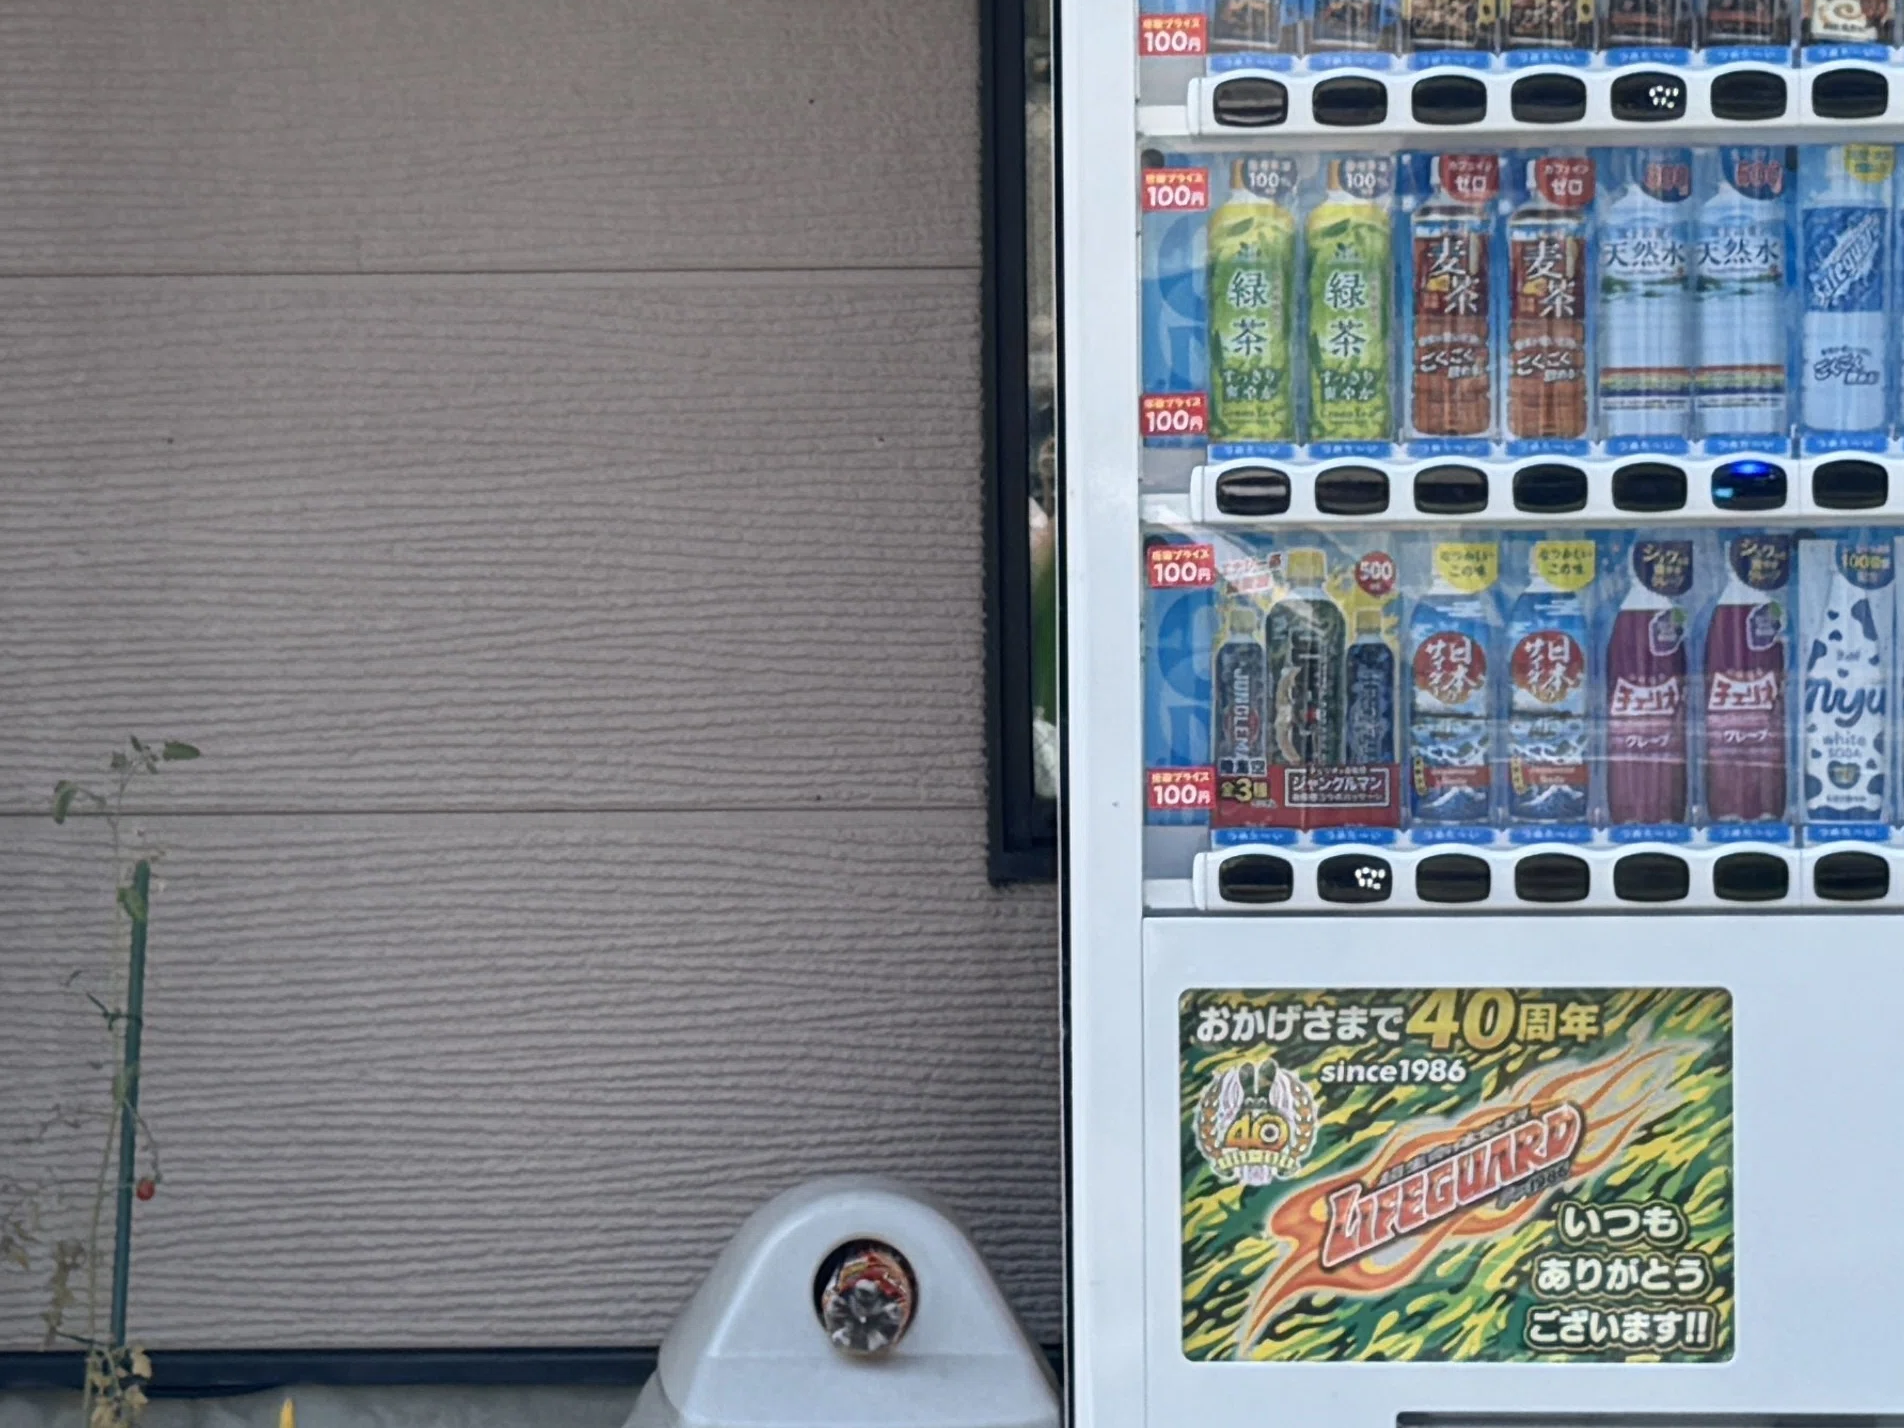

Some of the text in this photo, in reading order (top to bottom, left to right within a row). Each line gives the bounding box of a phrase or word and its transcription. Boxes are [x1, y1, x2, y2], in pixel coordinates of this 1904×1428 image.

[1143, 31, 1201, 52] 100円
[1146, 185, 1204, 207] 100円
[1456, 175, 1487, 193] ゼロ
[1551, 178, 1583, 197] ゼロ
[1604, 239, 1686, 267] 天然水
[1698, 238, 1780, 265] 天然水
[1427, 235, 1480, 316] 麦茶
[1523, 240, 1576, 318] 麦茶
[1228, 270, 1269, 357] 緑茶
[1326, 270, 1367, 358] 緑茶
[1420, 347, 1474, 372] ごくごく
[1517, 351, 1570, 376] ごくごく
[1146, 409, 1203, 431] 100円
[1153, 562, 1211, 583] 100円
[1612, 682, 1679, 713] チェリオ
[1709, 678, 1777, 707] チェリオ
[1625, 733, 1671, 748] グレープ
[1723, 729, 1768, 744] グレープ
[1822, 732, 1867, 748] white
[1153, 784, 1211, 804] 100円
[1293, 775, 1382, 792] ジャングルマン
[1196, 989, 1601, 1051] おかげさまで40周年
[1320, 1059, 1467, 1083] since1986
[1321, 1101, 1586, 1268] LIFEGUARD
[1564, 1206, 1678, 1238] いつも
[1538, 1256, 1707, 1291] ありがとう
[1530, 1309, 1706, 1345] ございます!!
